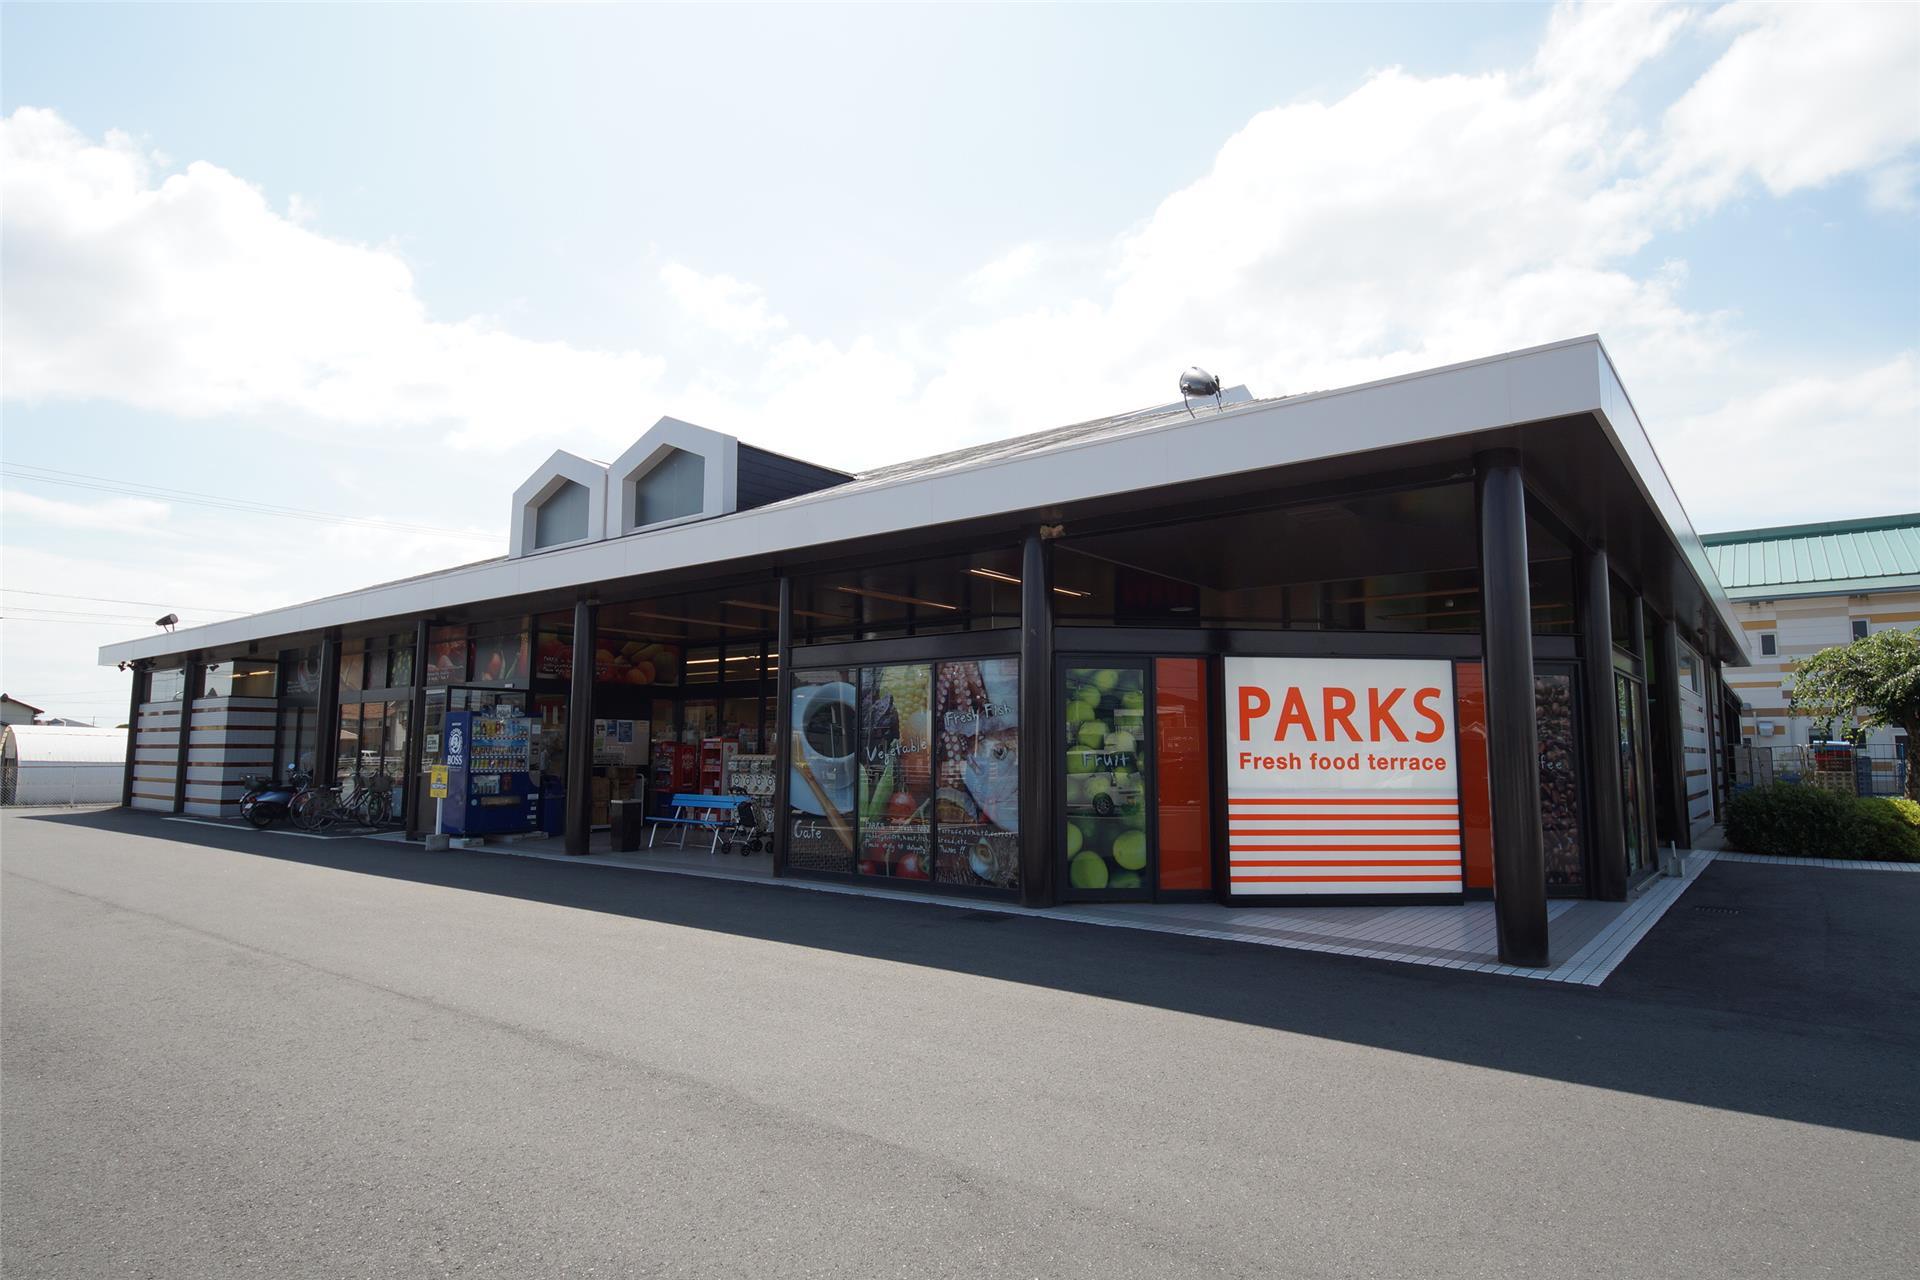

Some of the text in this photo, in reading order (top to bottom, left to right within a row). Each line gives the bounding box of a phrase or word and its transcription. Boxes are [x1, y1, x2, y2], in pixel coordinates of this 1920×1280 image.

[944, 703, 1012, 727] Fresh Fish
[1238, 686, 1445, 743] PARKS
[447, 755, 463, 765] BOSS
[867, 739, 927, 765] Vegetable
[1081, 752, 1129, 768] Fruit
[1239, 752, 1447, 771] Fresh food terrace
[793, 820, 822, 840] Cafe
